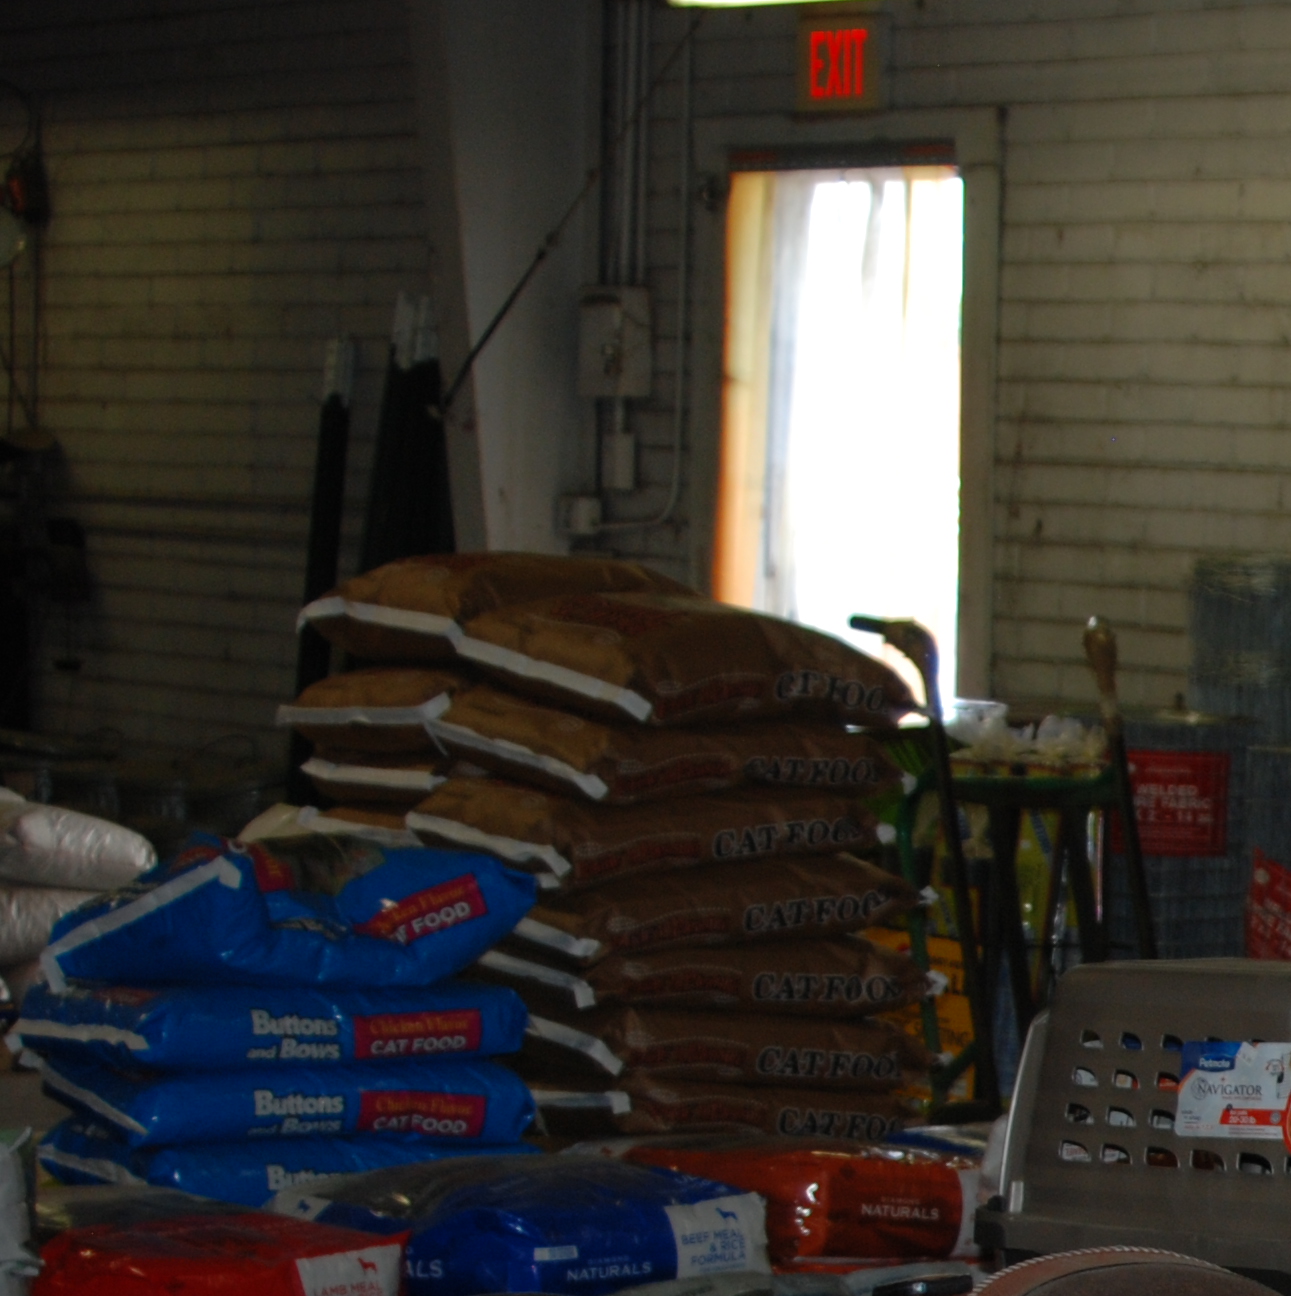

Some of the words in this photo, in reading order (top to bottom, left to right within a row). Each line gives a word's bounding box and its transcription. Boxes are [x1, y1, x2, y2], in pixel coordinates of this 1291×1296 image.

[811, 29, 868, 98] EXIT
[712, 823, 780, 861] CAT
[412, 900, 472, 932] FOOD
[742, 901, 811, 934] CAT
[752, 971, 821, 1002] CAT
[250, 1009, 339, 1037] Buttons
[279, 1036, 342, 1061] Bows
[369, 1039, 410, 1055] CAT
[410, 1035, 467, 1052] FOOD
[756, 1046, 826, 1077] CAT
[1197, 1083, 1263, 1097] NAVIGATOR
[253, 1089, 345, 1118] Buttons
[373, 1114, 411, 1131] CAT
[410, 1114, 468, 1135] FOOD
[778, 1107, 843, 1137] CAT
[861, 1203, 940, 1222] NATURALS
[681, 1231, 711, 1247] BEEF
[712, 1226, 745, 1242] MEAL
[720, 1237, 747, 1252] RICE
[689, 1248, 747, 1267] FORMULA
[565, 1260, 654, 1283] NATURALS
[350, 1280, 384, 1296] MEAL
